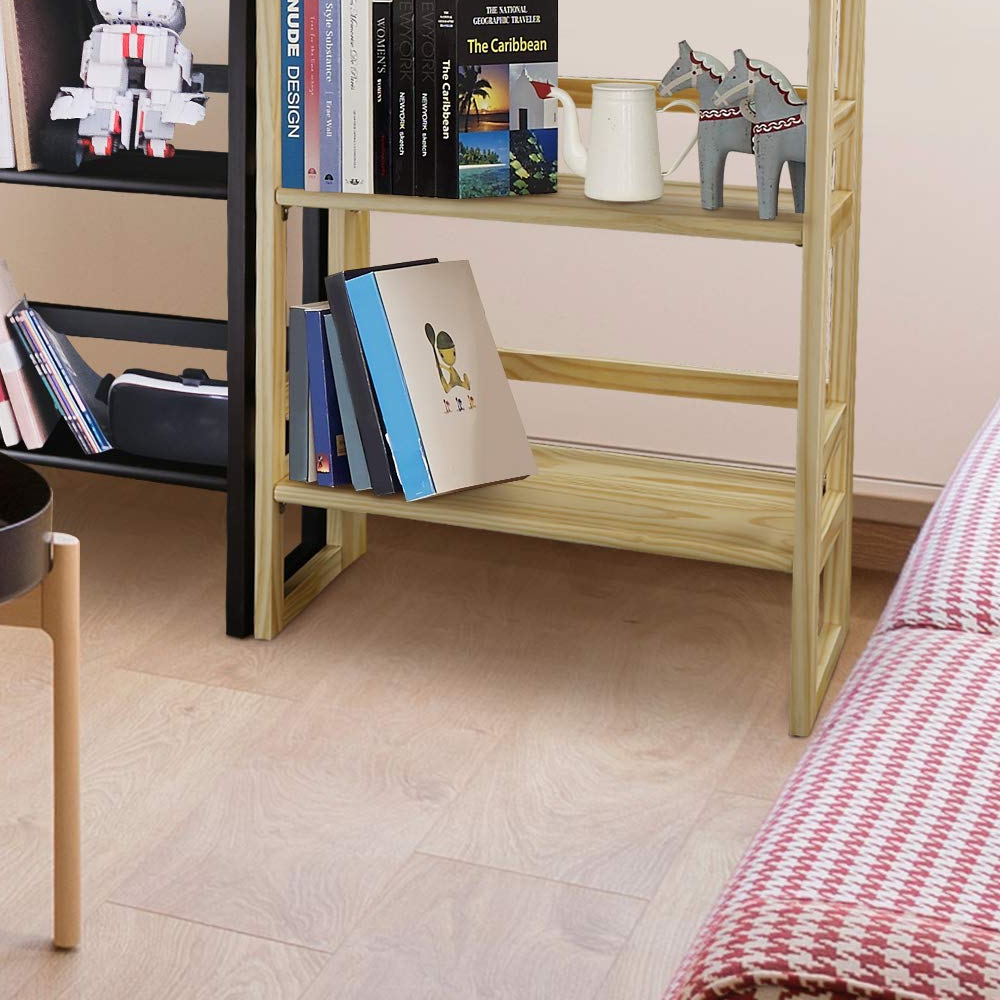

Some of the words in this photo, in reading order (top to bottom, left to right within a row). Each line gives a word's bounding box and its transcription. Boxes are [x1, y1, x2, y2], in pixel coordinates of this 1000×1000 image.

[324, 3, 333, 28] Style
[473, 16, 510, 25] GEOGRAPHIC
[511, 15, 541, 24] TRAVELER
[486, 6, 498, 14] THE
[499, 6, 528, 14] NATIONAL
[325, 30, 333, 82] Substance
[377, 17, 386, 74] WOMEN'S
[467, 38, 489, 54] The
[491, 37, 547, 53] Caribbean
[442, 60, 451, 80] The
[287, 65, 300, 138] DESIGN
[442, 82, 451, 140] Caribbean
